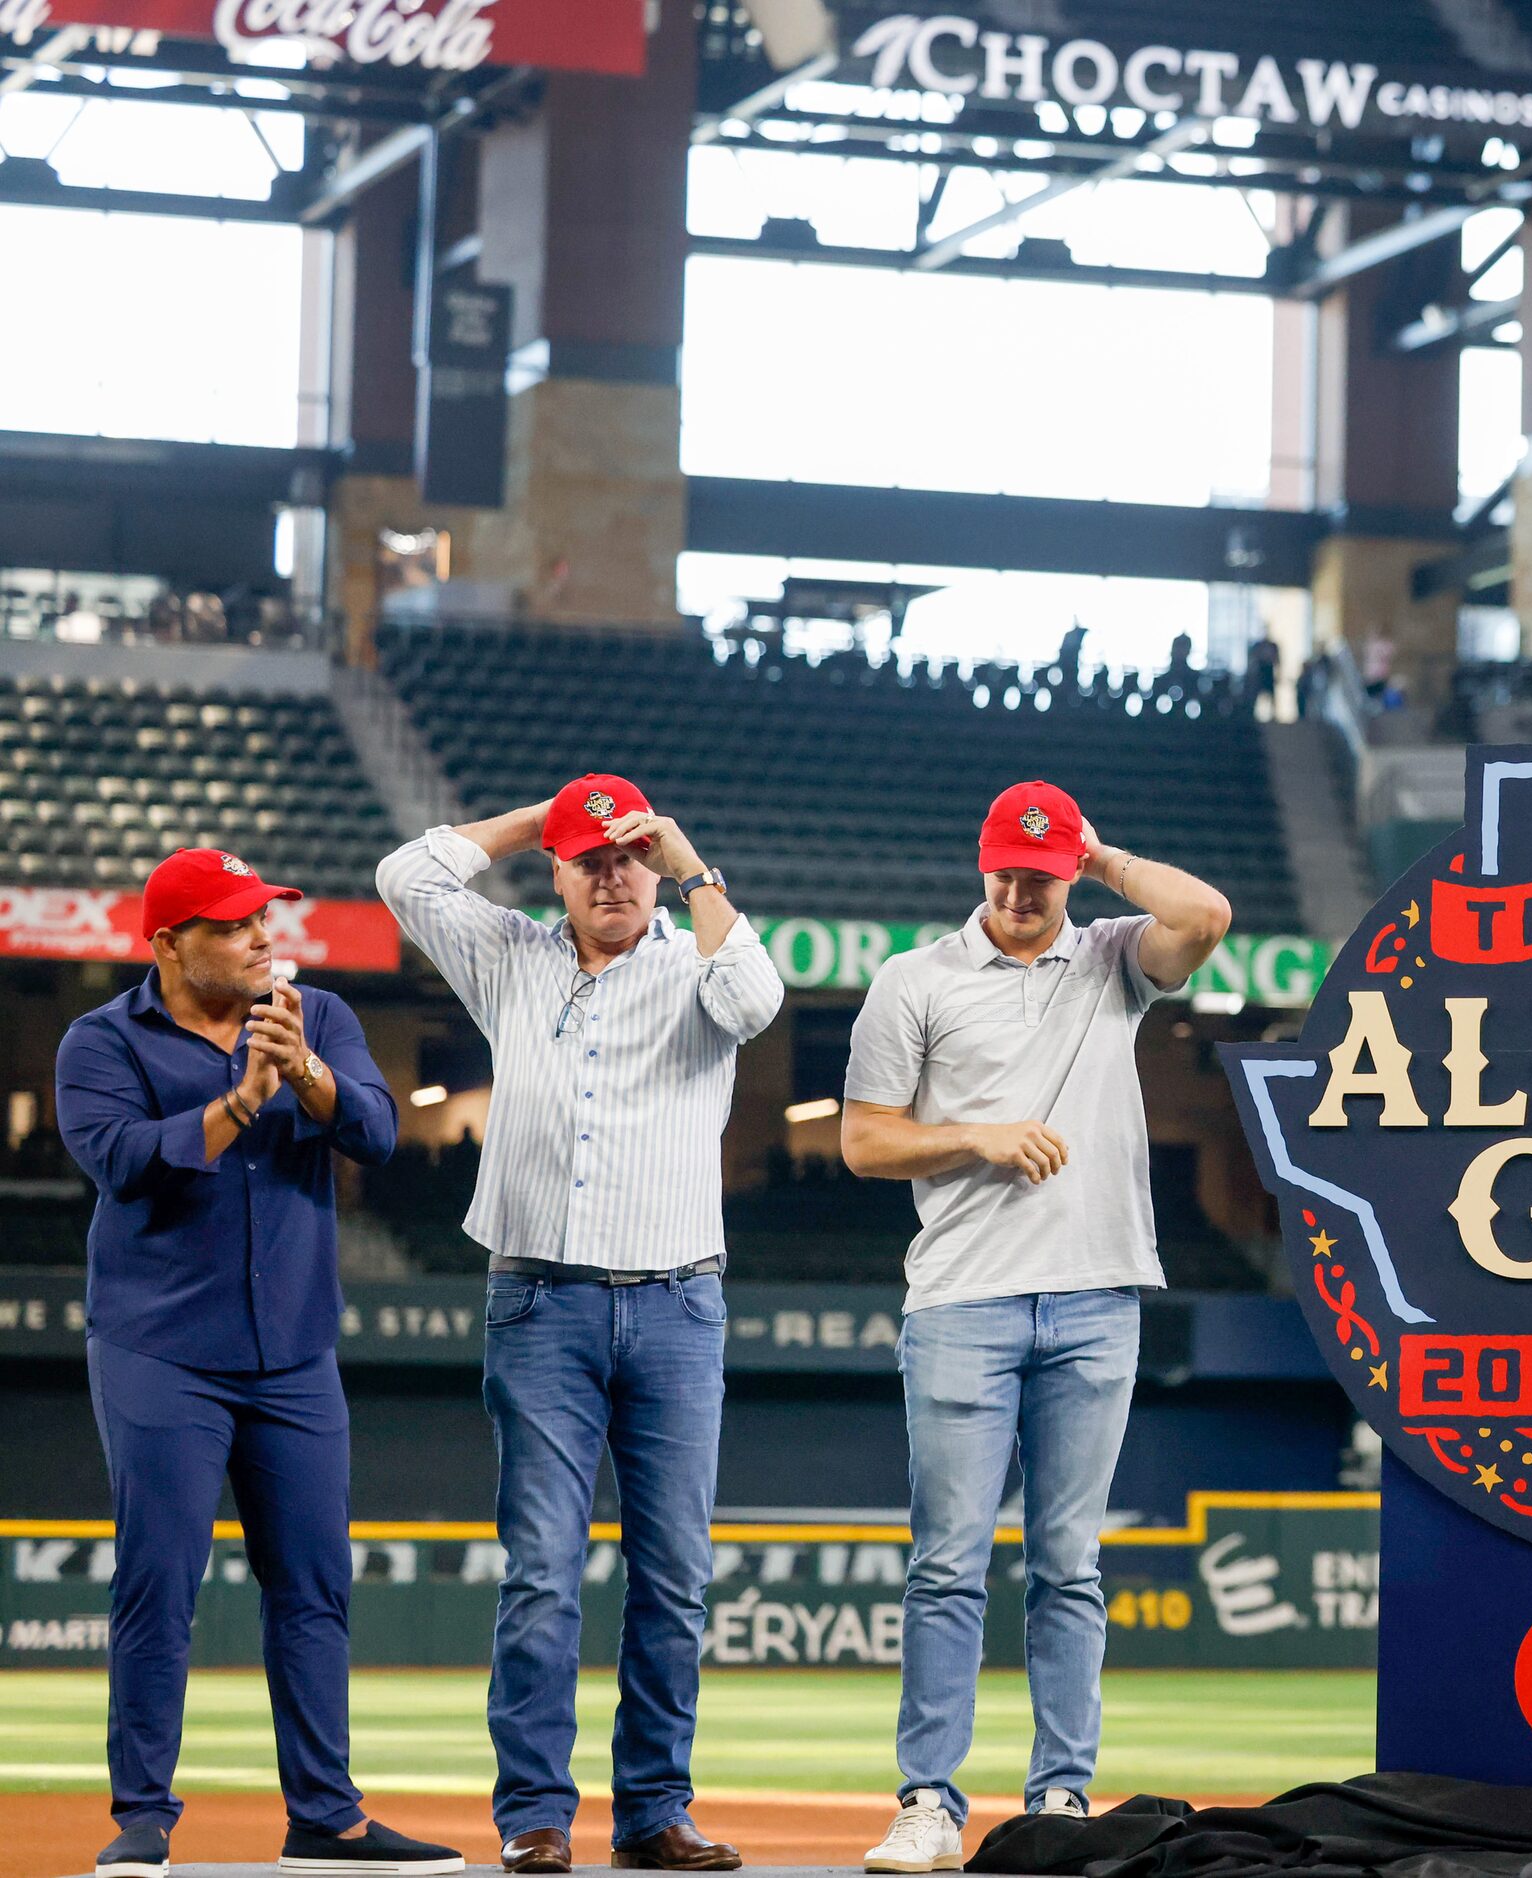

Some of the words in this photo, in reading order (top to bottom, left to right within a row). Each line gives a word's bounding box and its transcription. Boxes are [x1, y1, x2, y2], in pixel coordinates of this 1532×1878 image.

[908, 15, 1378, 129] CHOCTAW
[378, 1306, 474, 1338] STAY
[1421, 1347, 1522, 1403] 20
[1106, 1589, 1193, 1630] 410
